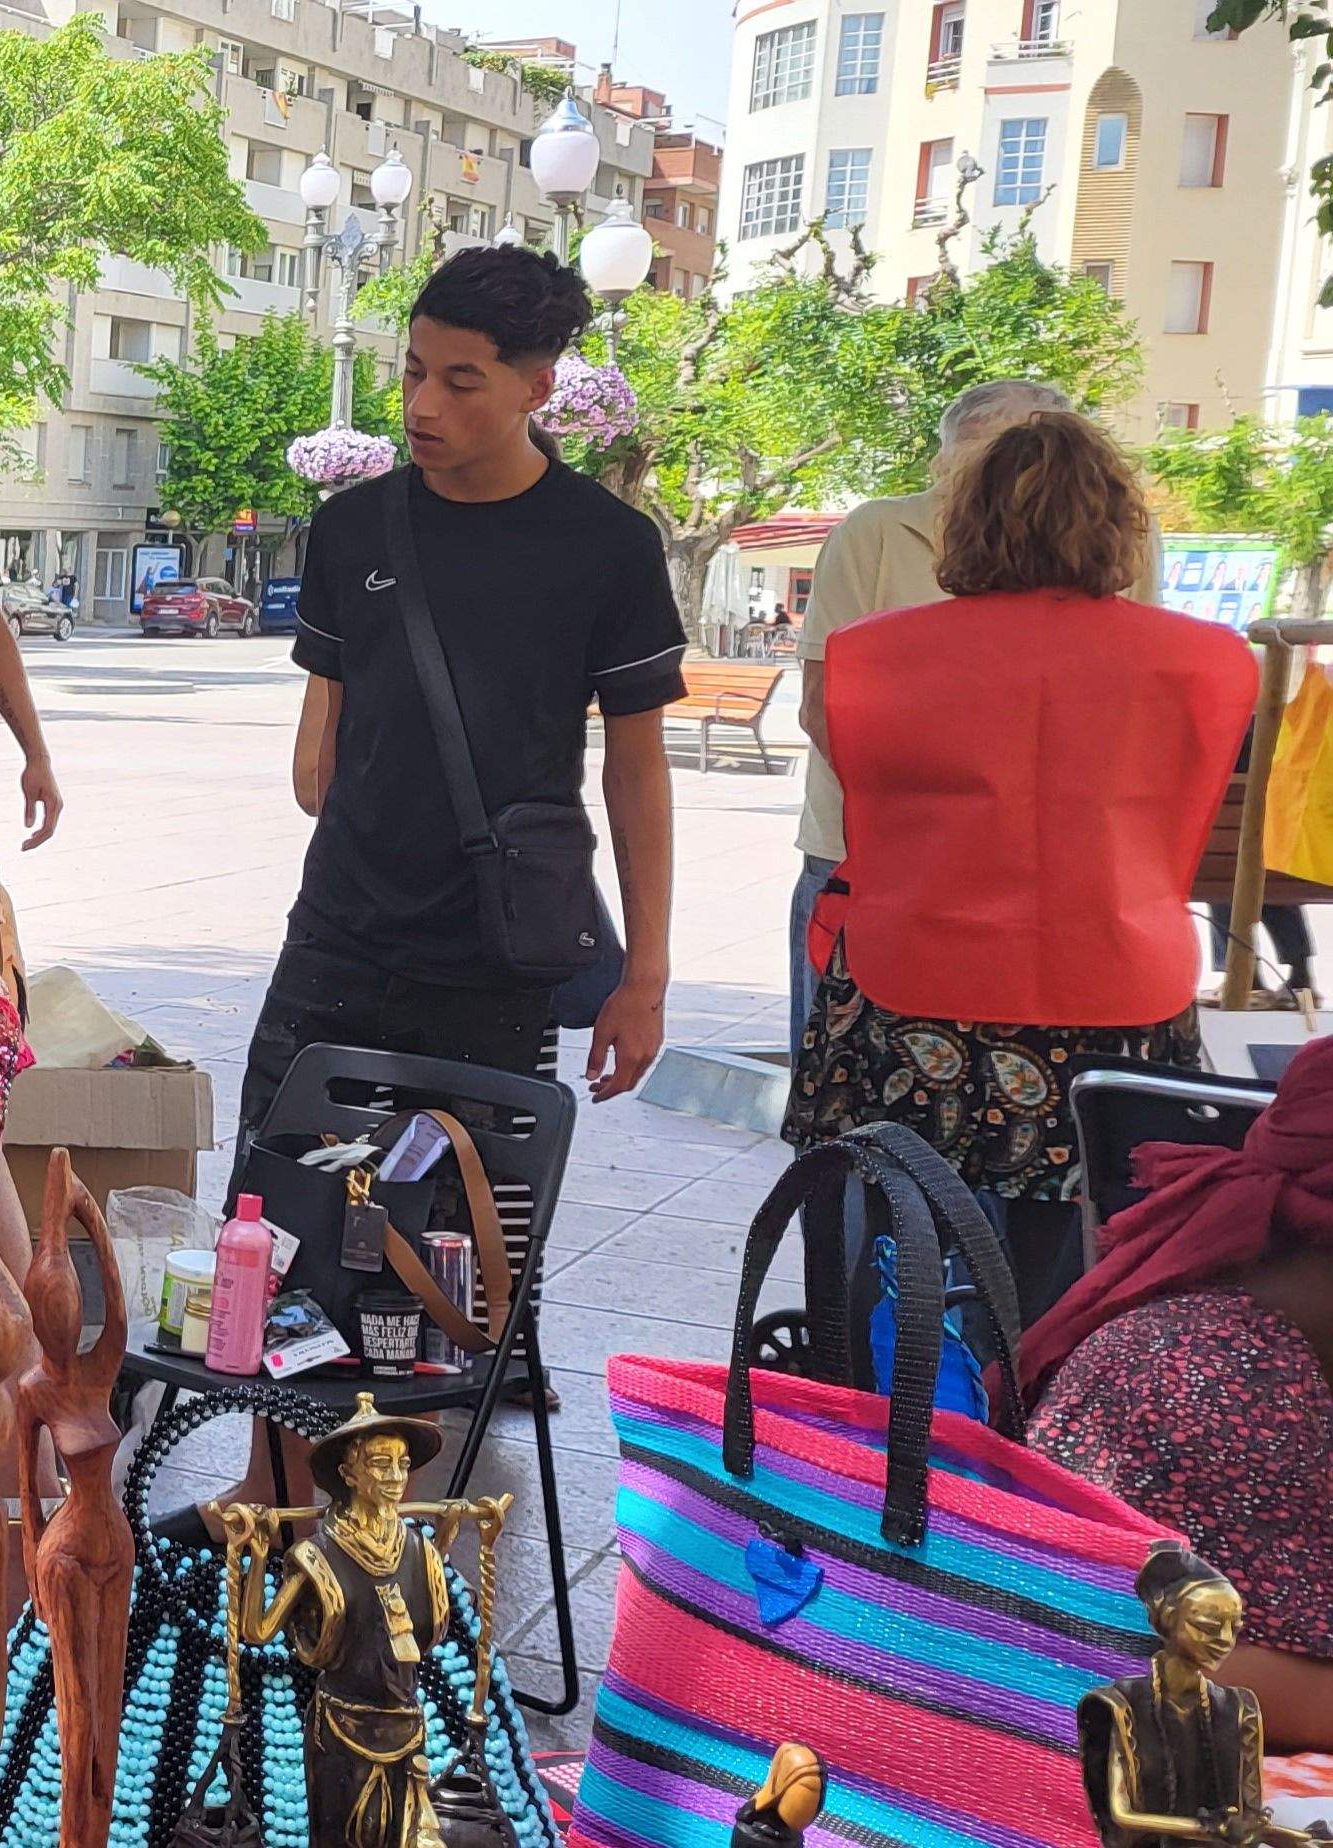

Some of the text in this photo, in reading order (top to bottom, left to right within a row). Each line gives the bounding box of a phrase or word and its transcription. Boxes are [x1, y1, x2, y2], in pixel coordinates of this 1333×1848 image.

[360, 1313, 385, 1326] NADA
[386, 1315, 402, 1327] ME
[364, 1347, 385, 1360] CADA
